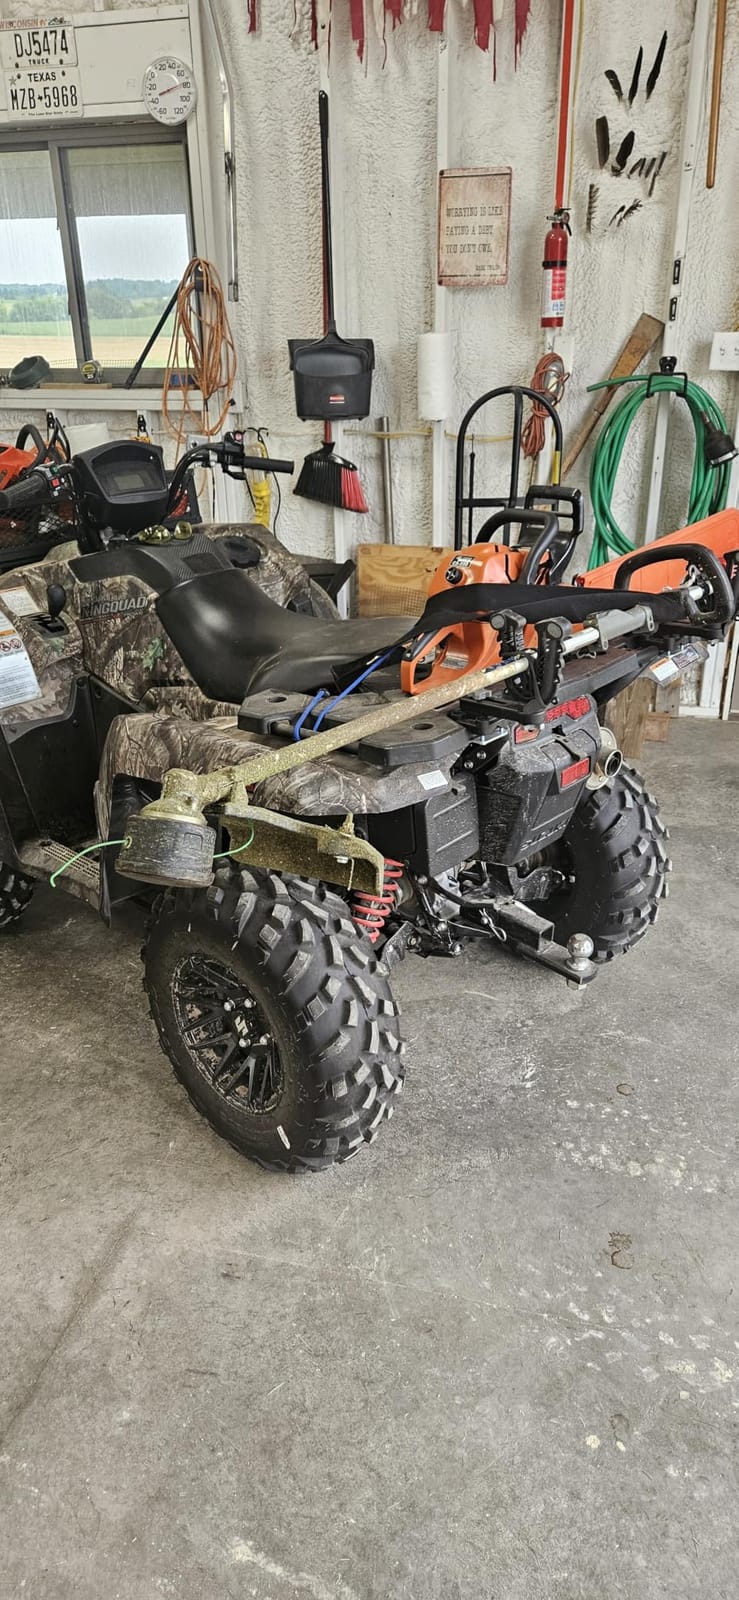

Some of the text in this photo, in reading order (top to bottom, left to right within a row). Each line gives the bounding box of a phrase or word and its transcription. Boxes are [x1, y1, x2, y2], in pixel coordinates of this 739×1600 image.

[14, 30, 68, 57] DJ5474
[167, 62, 177, 70] 40
[27, 72, 57, 82] TEXAS
[150, 71, 156, 79] 0
[182, 81, 191, 89] 80
[179, 95, 191, 103] 100
[173, 107, 184, 115] 120
[446, 206, 478, 217] WORRYING
[479, 206, 487, 216] IS
[445, 225, 470, 236] PAYING
[471, 225, 476, 235] A
[81, 596, 146, 618] KINGQUAD
